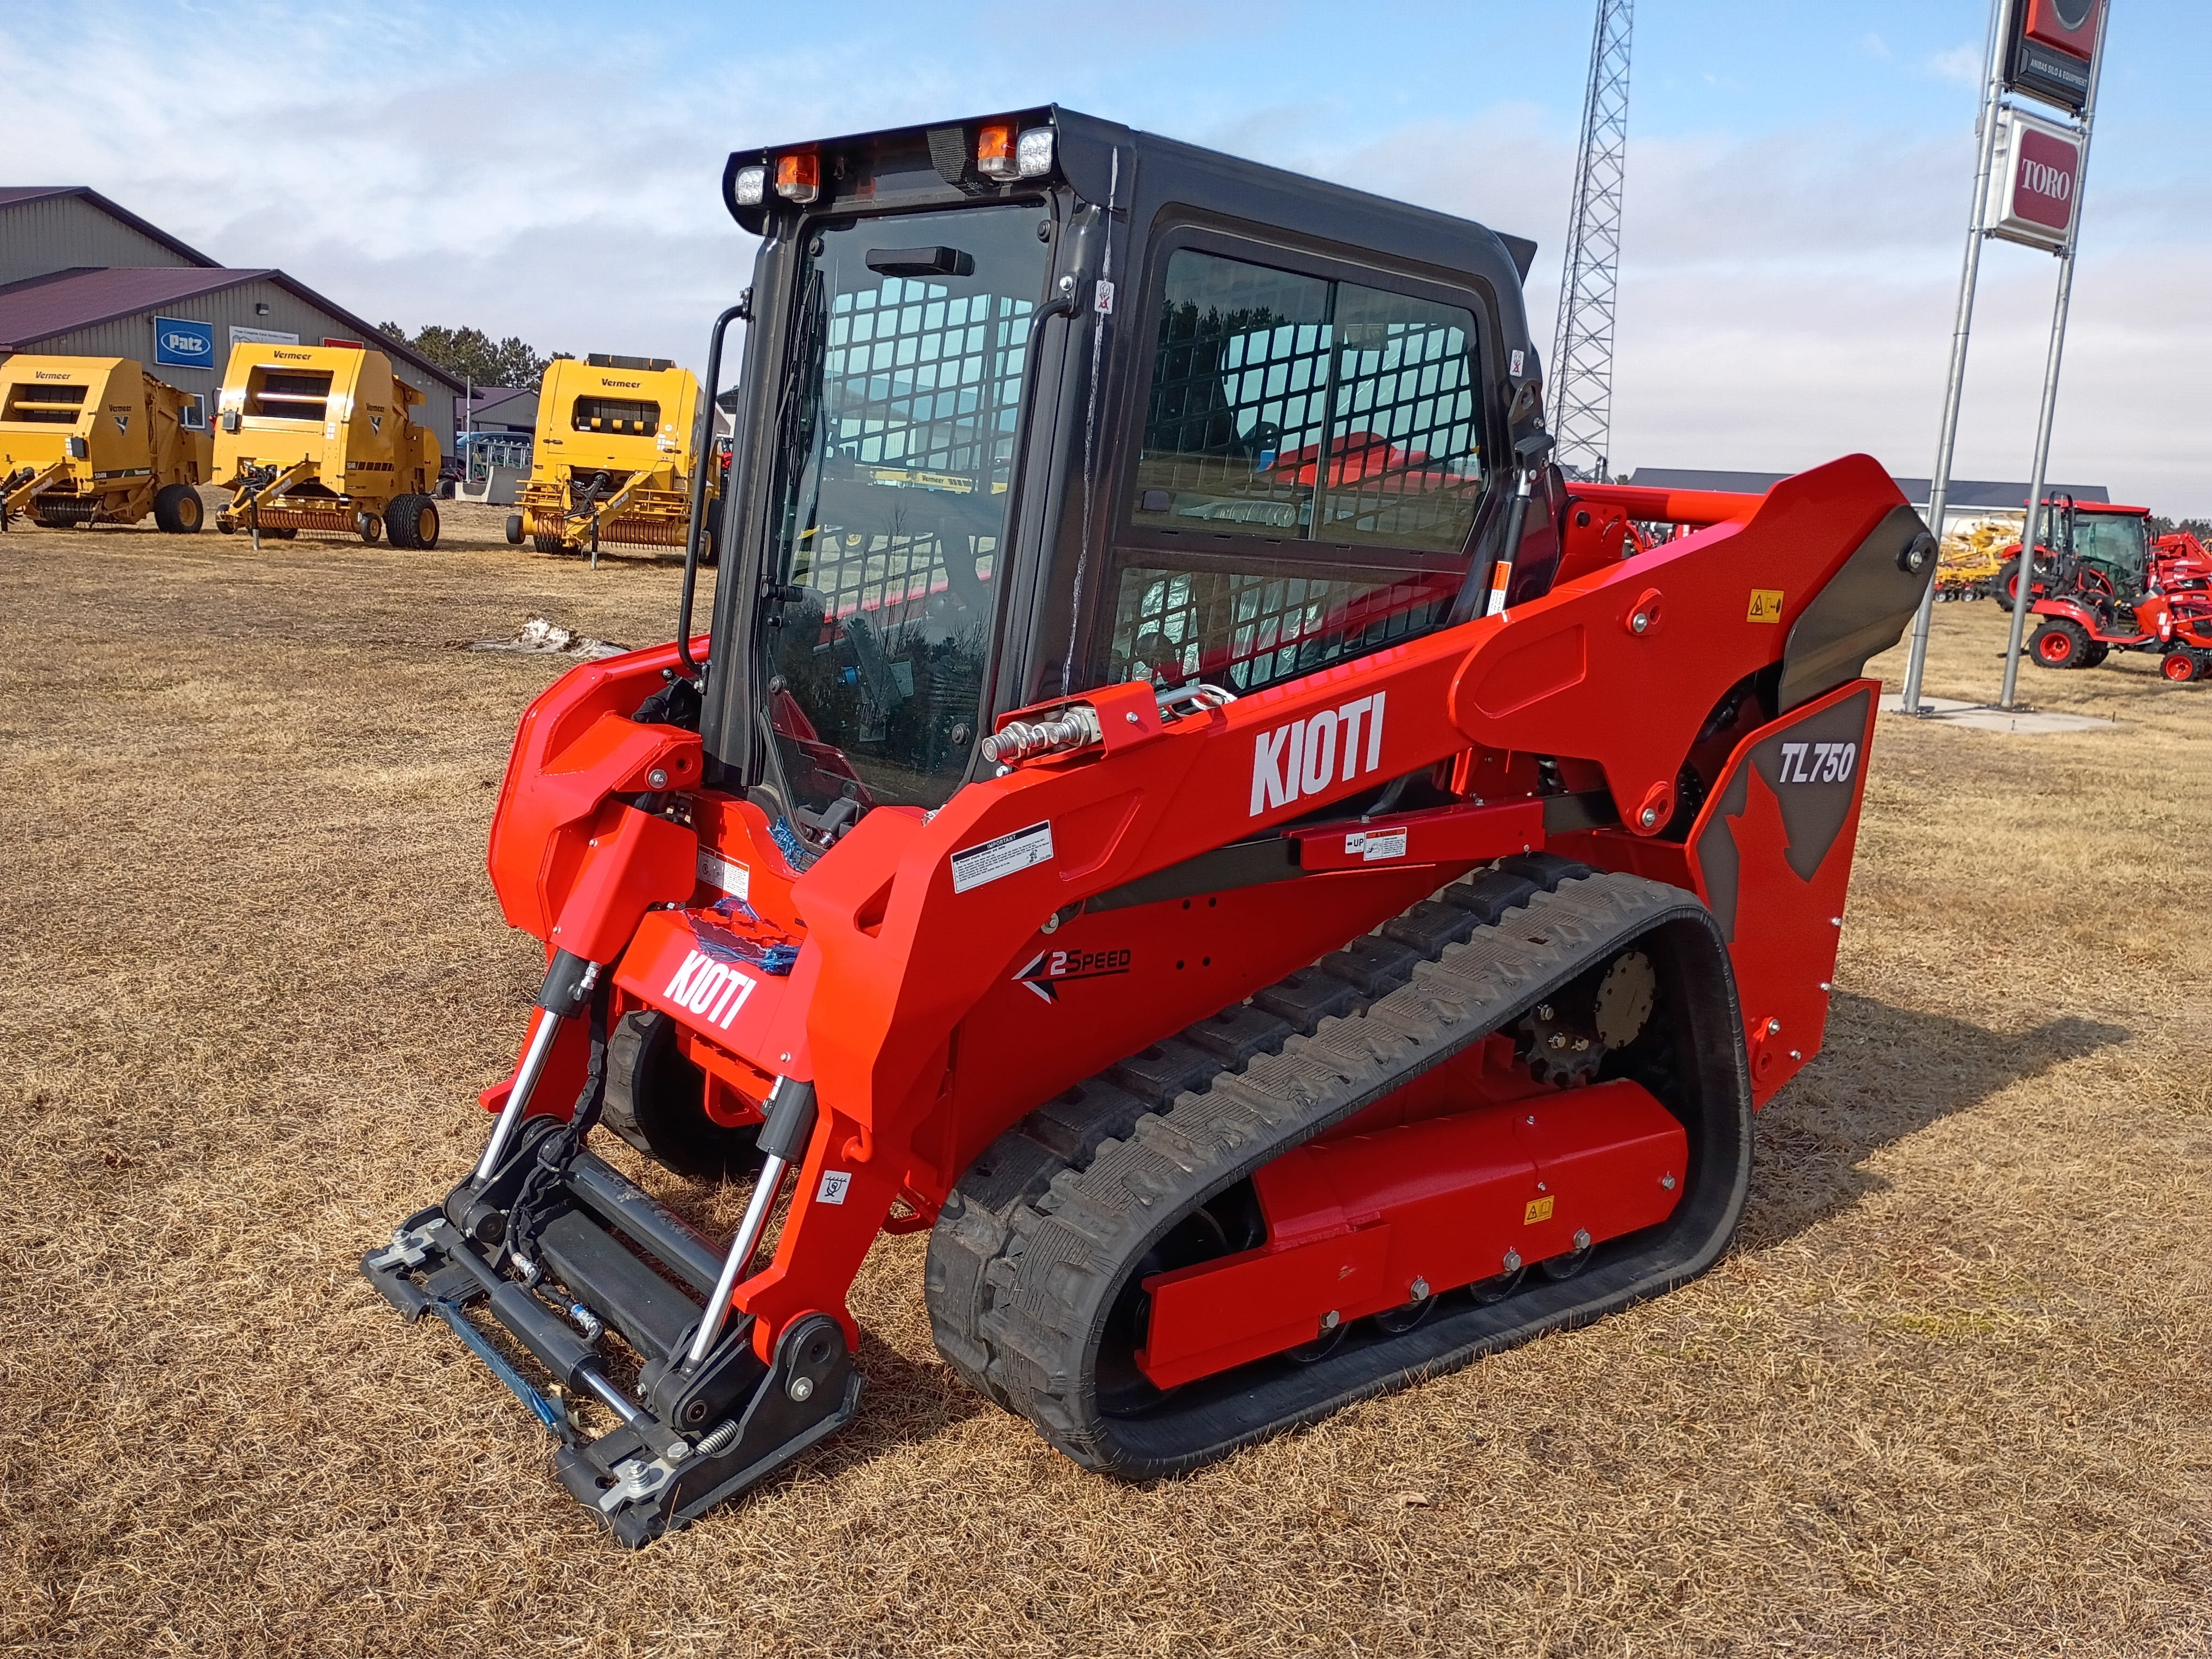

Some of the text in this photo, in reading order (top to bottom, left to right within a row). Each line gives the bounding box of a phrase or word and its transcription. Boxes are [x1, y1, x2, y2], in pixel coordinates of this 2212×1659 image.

[2047, 65, 2058, 76] SILO
[2062, 70, 2087, 87] EQUIPMENT
[2022, 158, 2070, 201] TORO
[169, 334, 202, 351] Patz
[274, 350, 312, 360] Vermeer
[36, 371, 71, 380] Vermeer
[601, 378, 641, 388] Vermeer
[108, 404, 131, 412] Vermeer
[366, 403, 384, 412] Vermeer
[922, 475, 944, 484] Vermeer
[1249, 691, 1386, 817] KIOTI
[1779, 742, 1856, 783] TL750
[987, 834, 1017, 850] IMPORTANT
[1354, 838, 1364, 847] UP
[663, 949, 757, 1030] KIOTI
